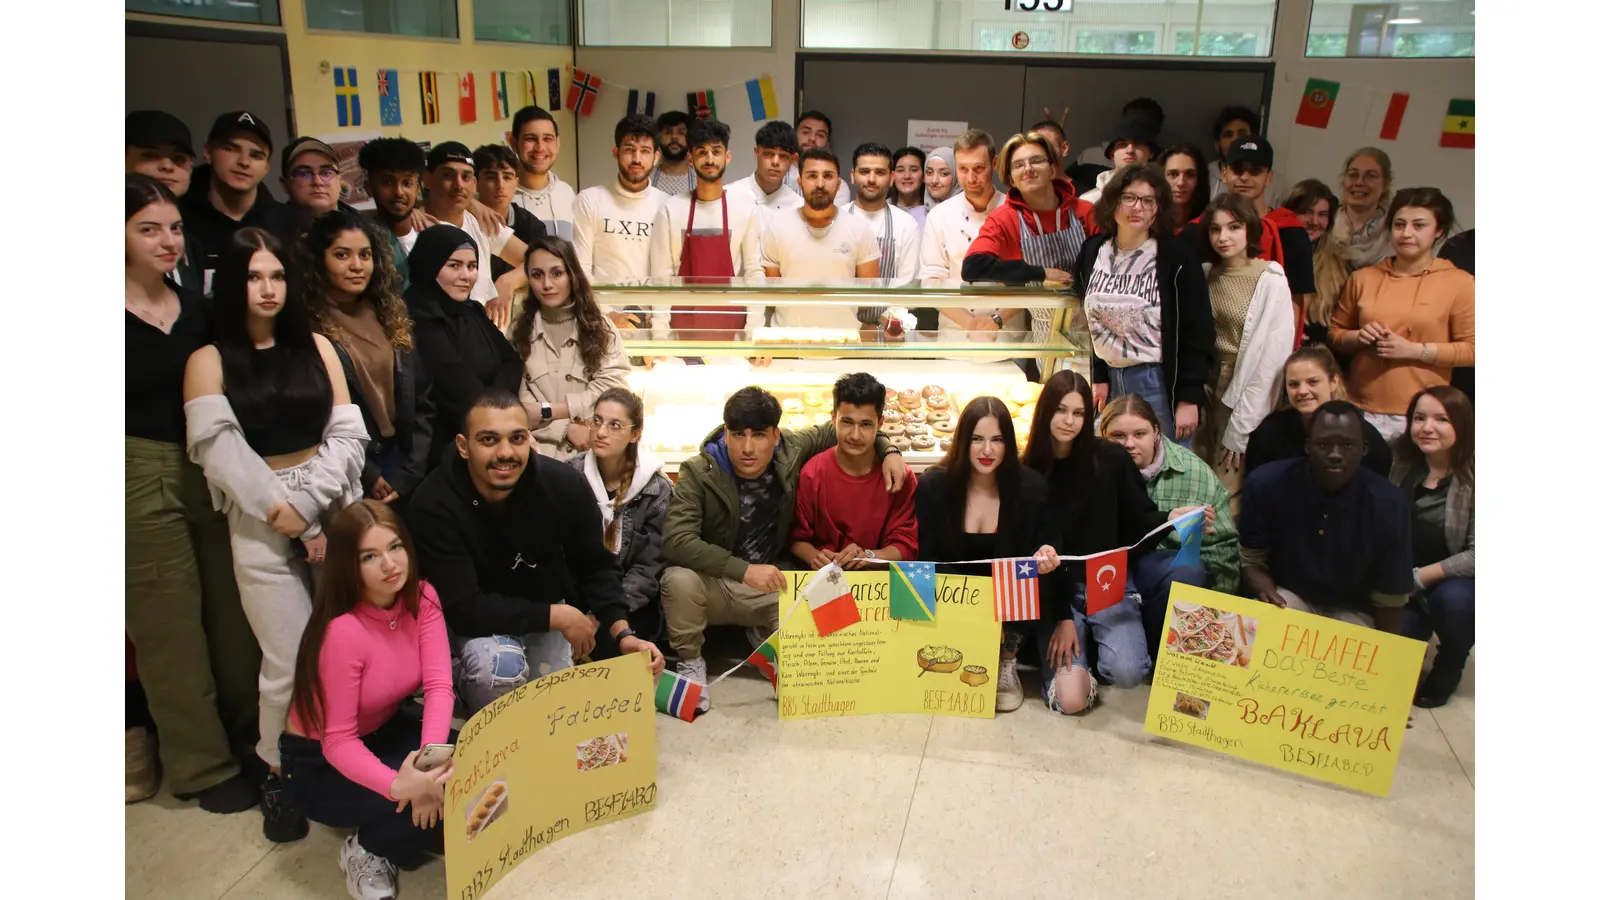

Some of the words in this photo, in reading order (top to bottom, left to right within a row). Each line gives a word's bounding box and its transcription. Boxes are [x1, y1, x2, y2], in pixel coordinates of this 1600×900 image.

[603, 218, 654, 237] LXR
[1281, 624, 1379, 675] FALAFEL
[532, 666, 611, 700] Speisen
[1263, 648, 1307, 676] Das
[1313, 662, 1369, 691] Beste
[547, 693, 643, 736] Falafel
[782, 695, 797, 716] BBS
[801, 693, 856, 716] Stadthagen
[923, 689, 946, 710] BESF
[1158, 713, 1184, 733] BBS
[1187, 721, 1244, 749] Stadthagen
[462, 860, 493, 900] BBS
